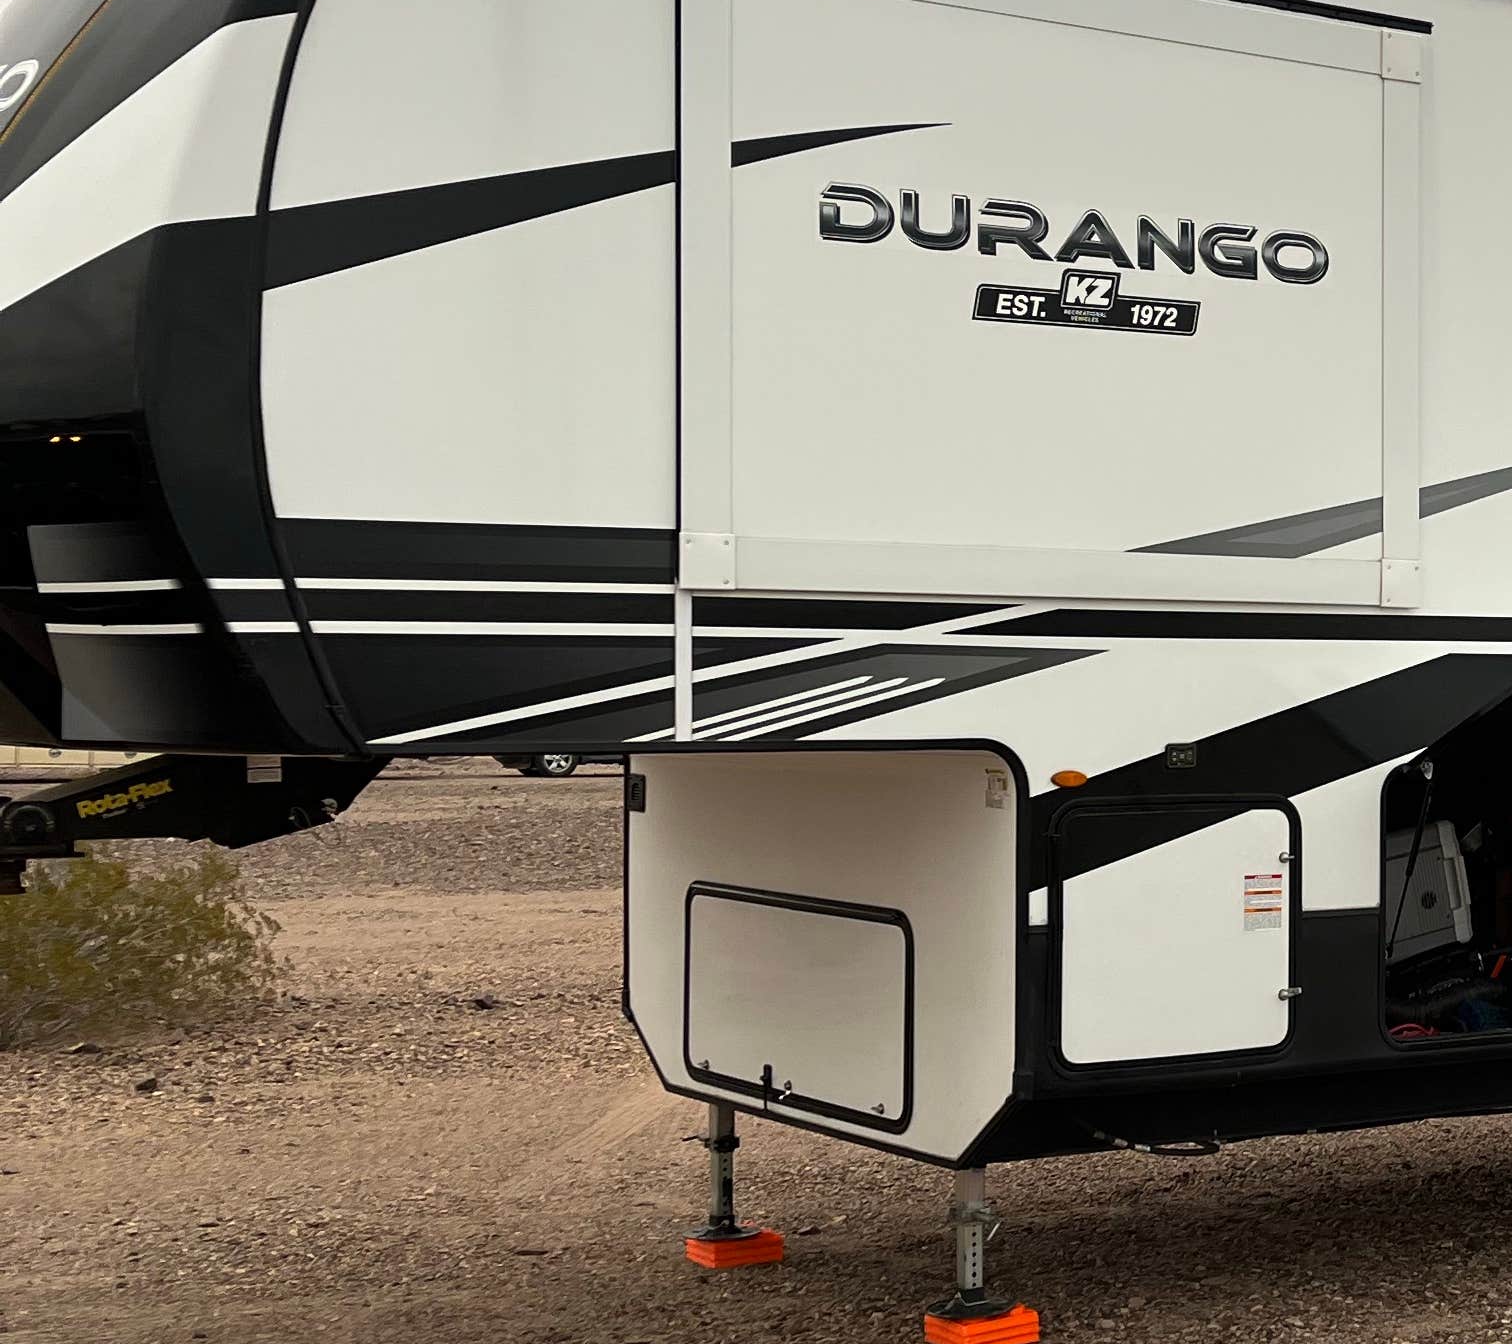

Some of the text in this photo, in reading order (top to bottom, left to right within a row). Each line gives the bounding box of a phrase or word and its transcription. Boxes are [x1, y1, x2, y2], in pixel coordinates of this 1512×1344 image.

[818, 181, 1329, 285] DURANGO
[1066, 276, 1113, 306] KZ
[996, 293, 1178, 327] EST. 1972
